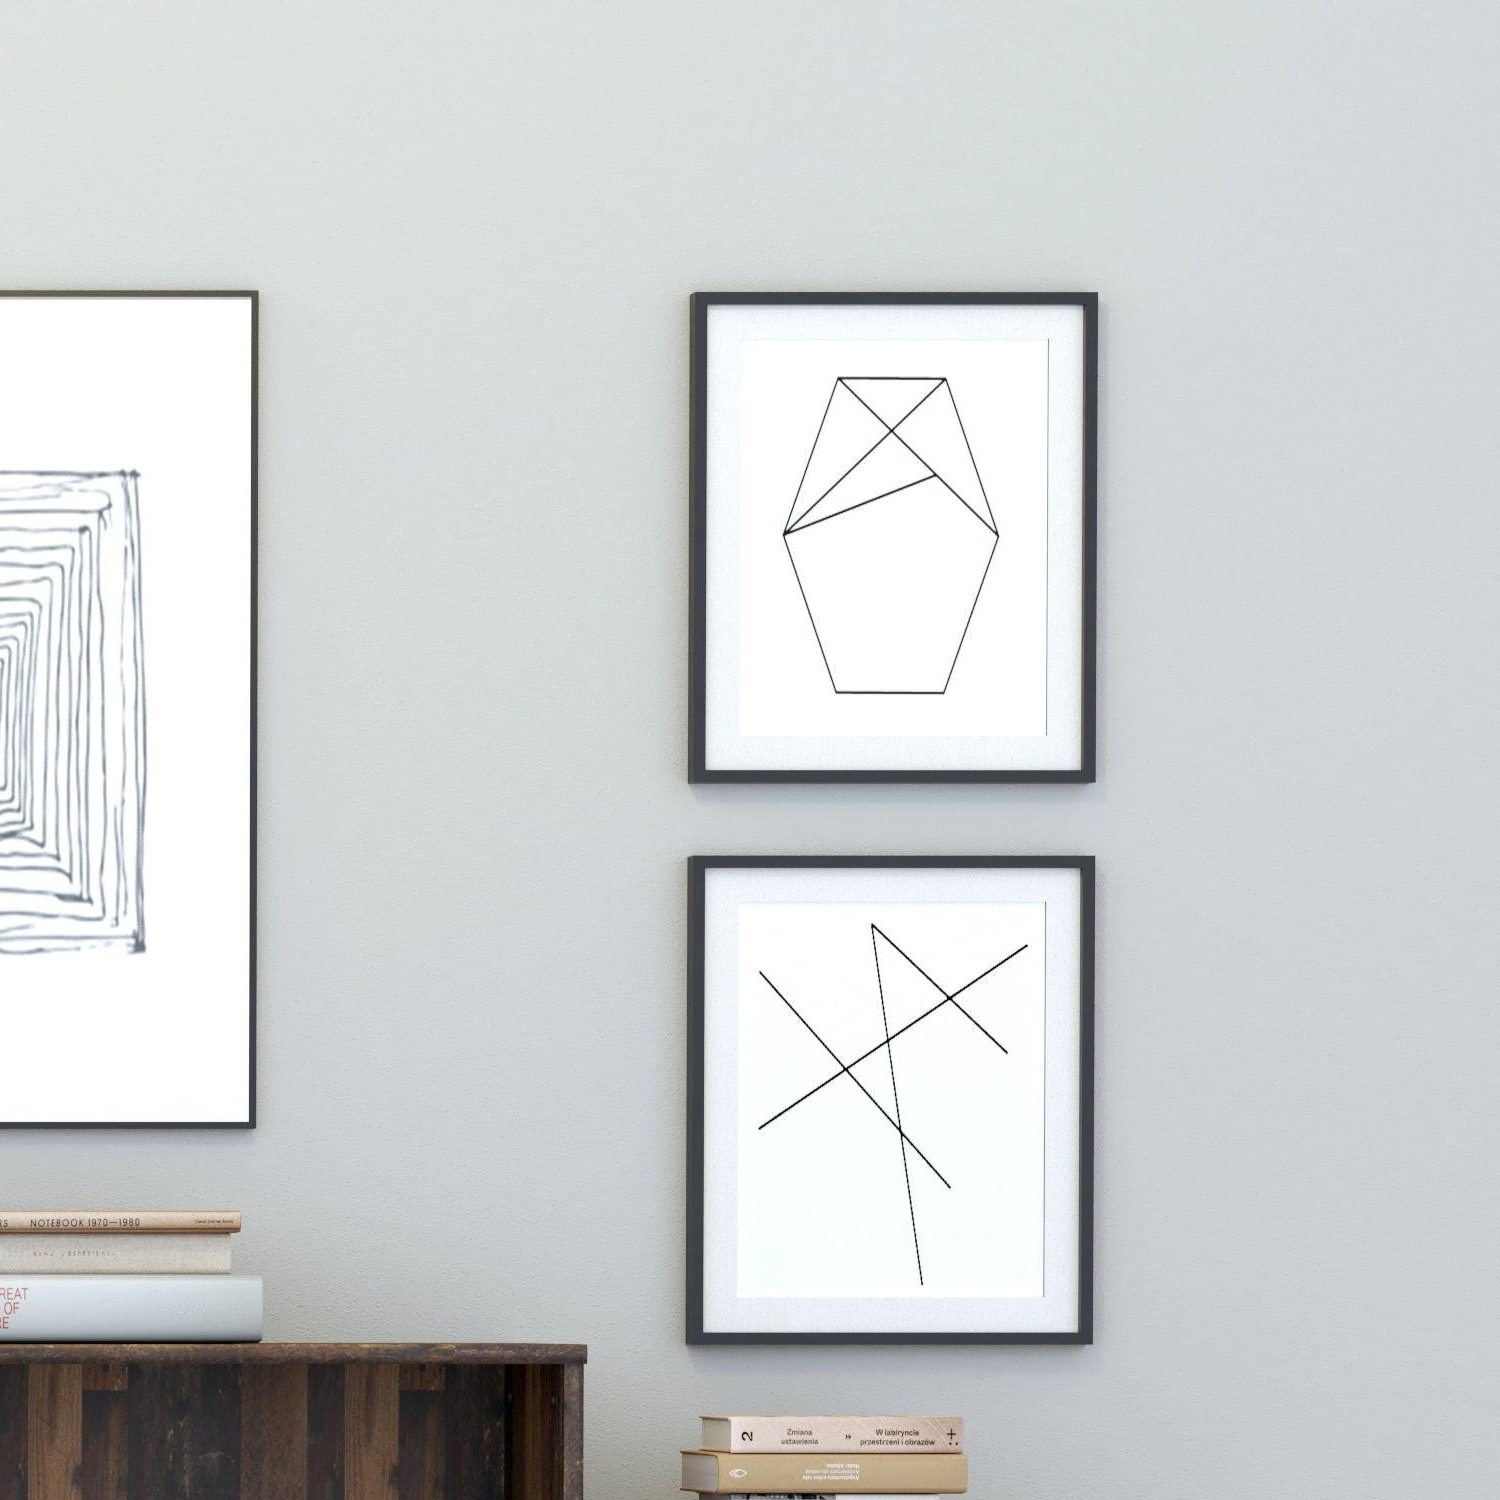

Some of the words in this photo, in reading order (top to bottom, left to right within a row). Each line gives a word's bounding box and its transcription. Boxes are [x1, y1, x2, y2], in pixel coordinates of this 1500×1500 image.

[30, 1218, 84, 1227] NOTEBOOK
[4, 1302, 20, 1314] OF
[741, 1431, 753, 1442] 2
[885, 1429, 920, 1437] labiryncie
[860, 1438, 900, 1446] przestrzeni
